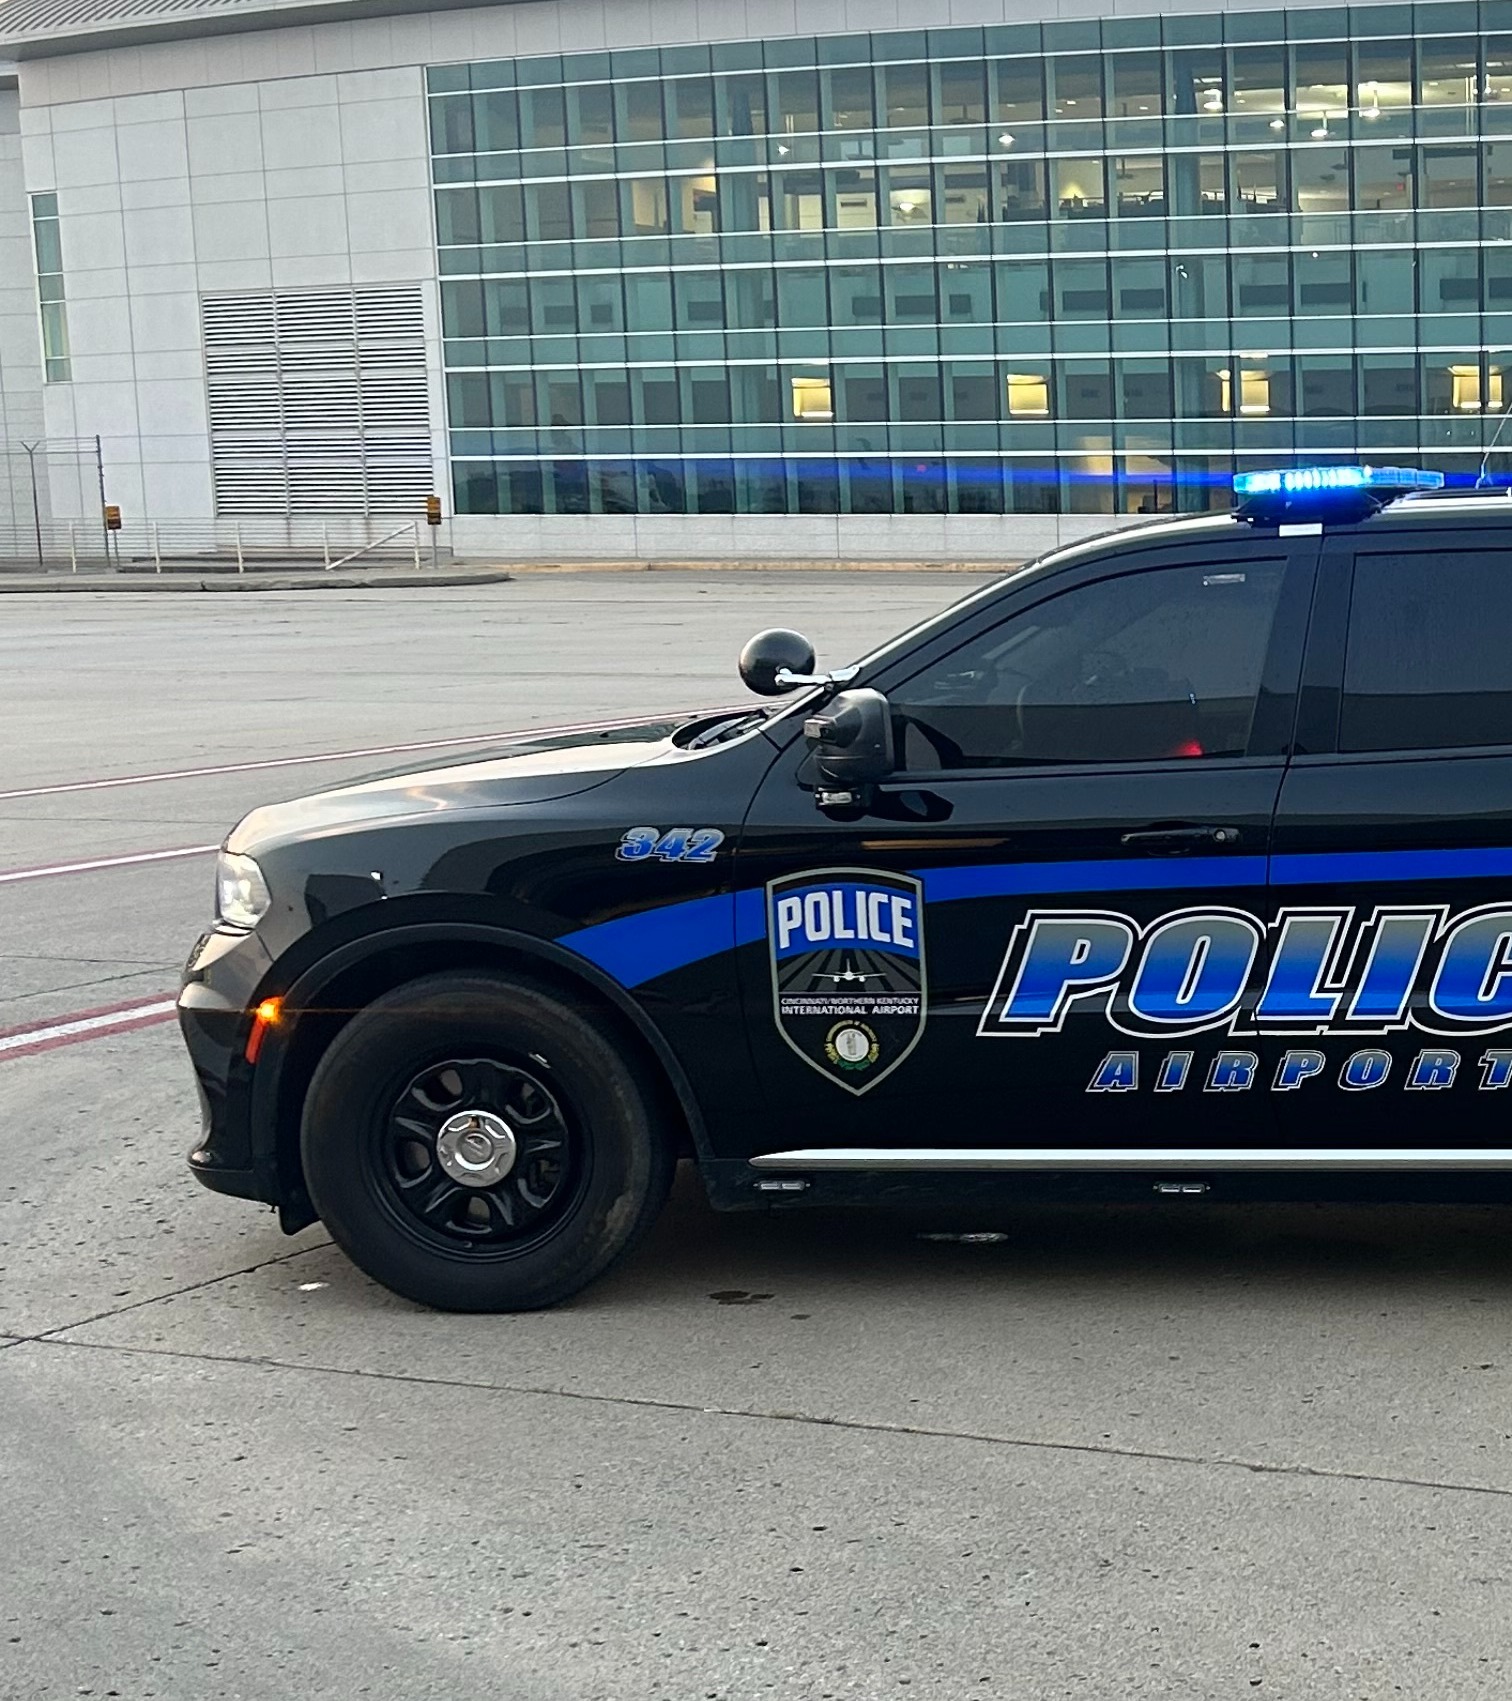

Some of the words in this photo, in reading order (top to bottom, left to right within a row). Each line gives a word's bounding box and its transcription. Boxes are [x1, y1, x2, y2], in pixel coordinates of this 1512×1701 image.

[614, 826, 725, 863] 342
[777, 890, 915, 949] POLICE
[781, 1005, 868, 1015] INTERNATIONAL
[872, 1005, 919, 1015] AIRPORT
